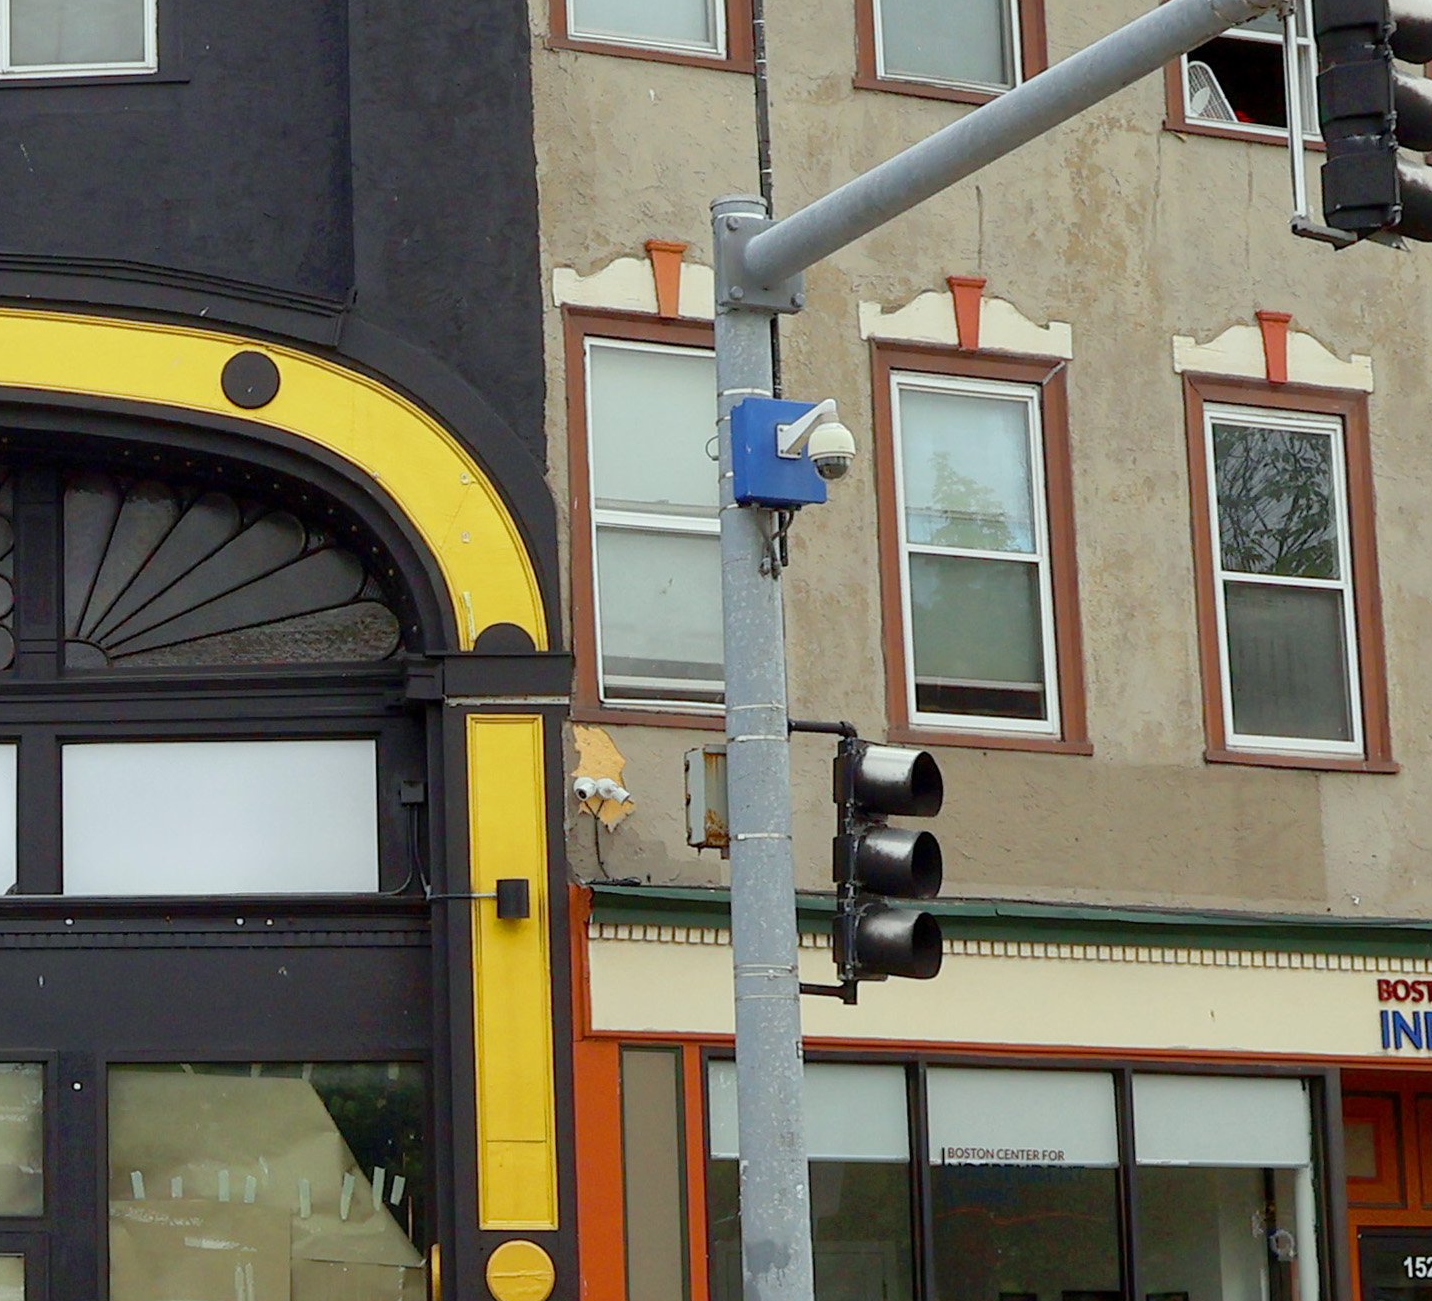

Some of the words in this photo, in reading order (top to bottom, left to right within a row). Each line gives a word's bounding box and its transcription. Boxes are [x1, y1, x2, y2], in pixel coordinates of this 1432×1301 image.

[947, 1147, 994, 1160] BOSTON
[996, 1149, 1041, 1161] CENTER
[1042, 1150, 1065, 1161] FOR
